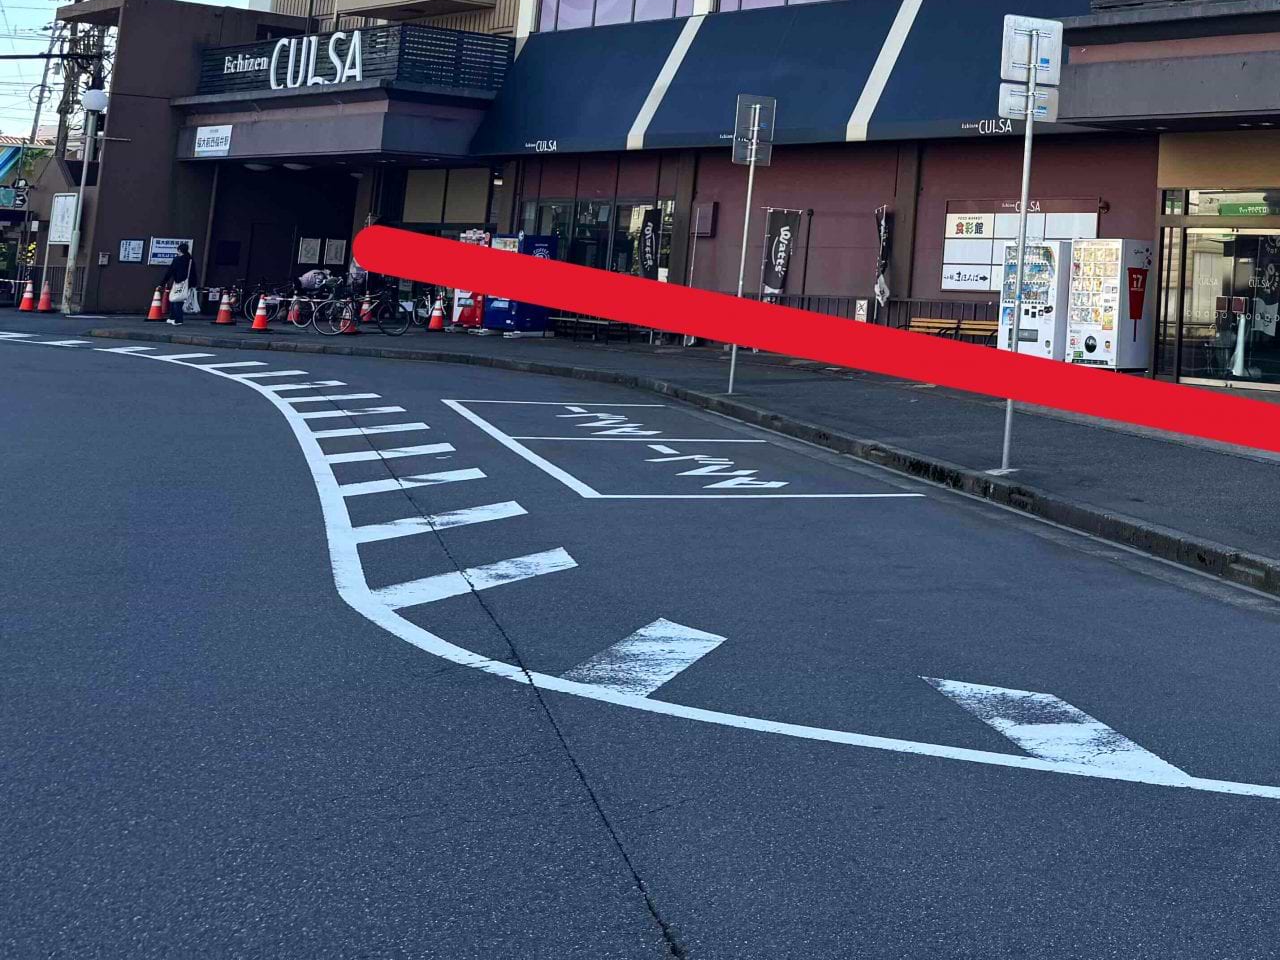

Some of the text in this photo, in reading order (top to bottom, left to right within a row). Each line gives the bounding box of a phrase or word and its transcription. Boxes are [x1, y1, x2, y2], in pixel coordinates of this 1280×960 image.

[224, 30, 363, 89] Echizen CULSA
[979, 119, 1012, 134] CULSA
[536, 140, 556, 151] CULSA
[1015, 201, 1041, 212] CSA
[955, 221, 984, 235] 食彩館
[775, 226, 791, 272] Watts
